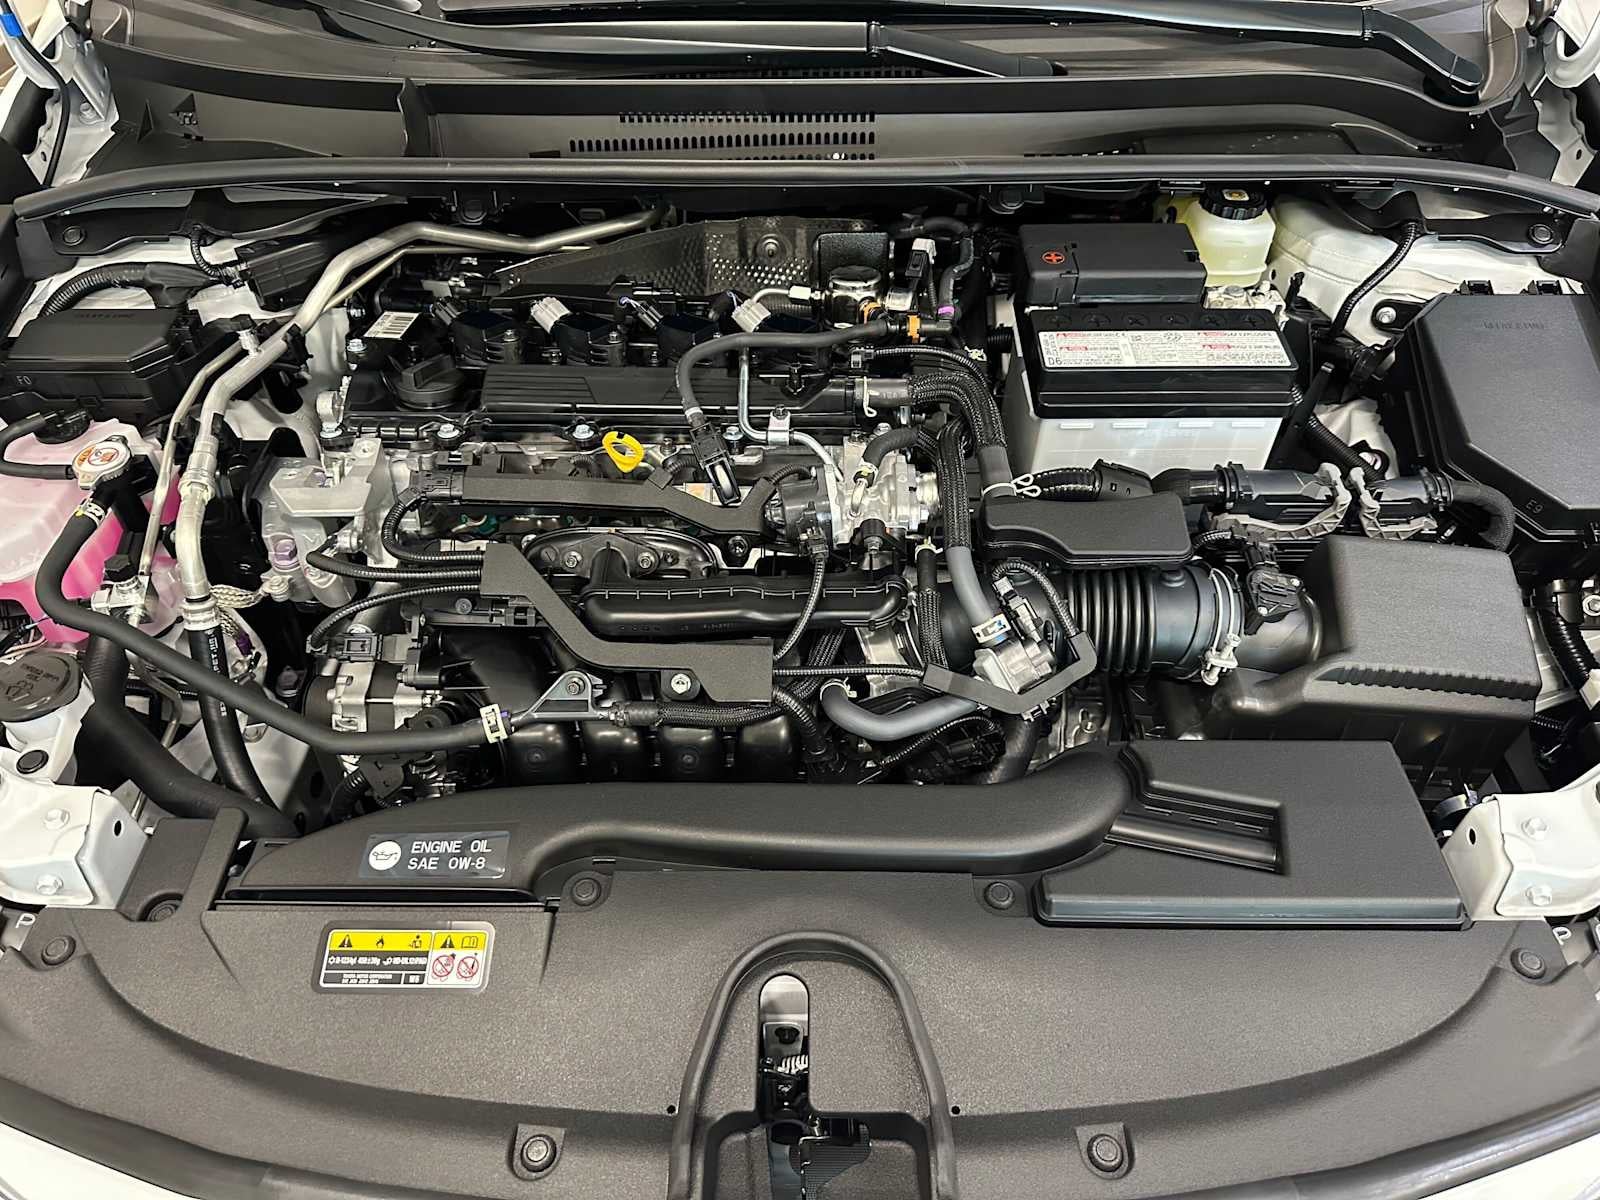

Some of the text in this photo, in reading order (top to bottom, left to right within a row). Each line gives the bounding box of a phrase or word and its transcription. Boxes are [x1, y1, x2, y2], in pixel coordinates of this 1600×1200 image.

[411, 839, 492, 854] ENGINE OIL
[407, 857, 440, 870] SAE
